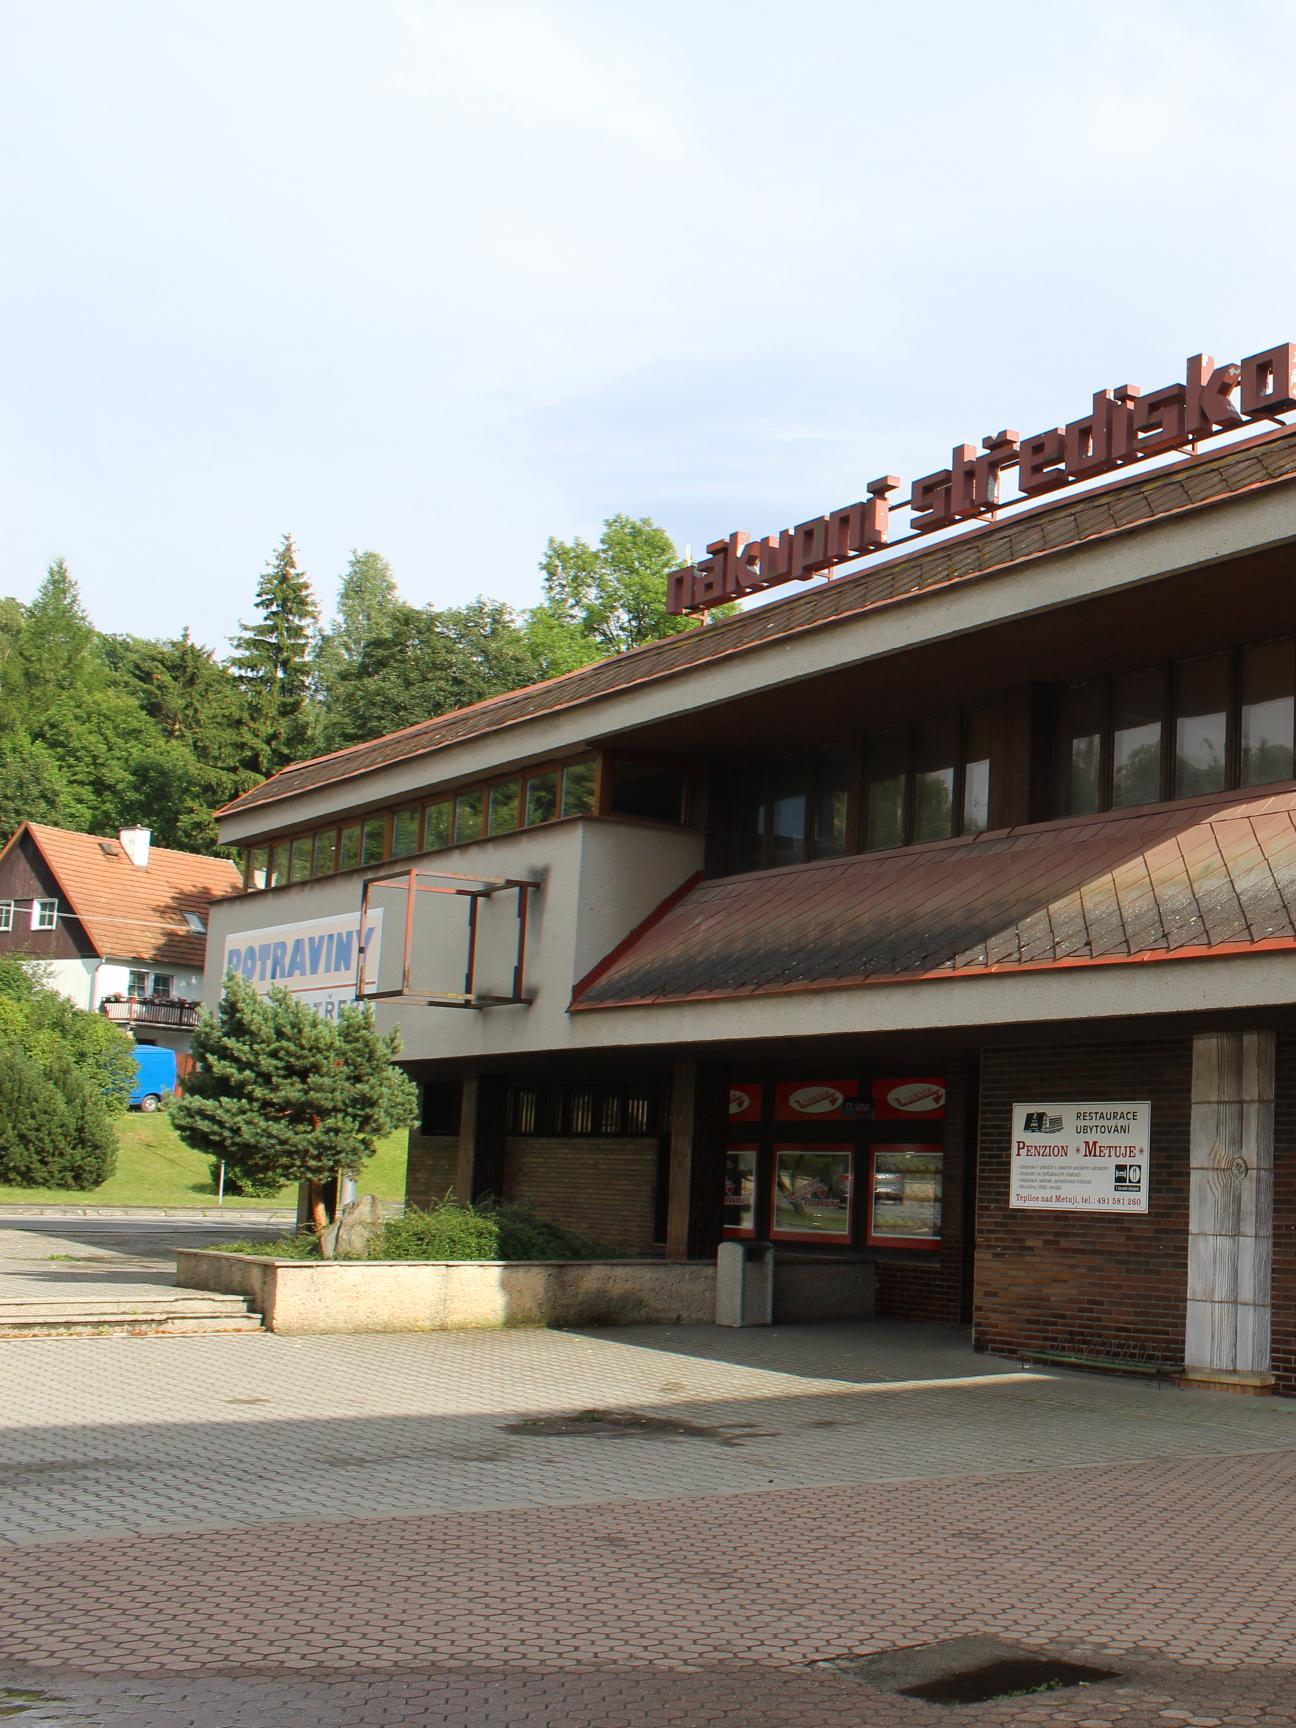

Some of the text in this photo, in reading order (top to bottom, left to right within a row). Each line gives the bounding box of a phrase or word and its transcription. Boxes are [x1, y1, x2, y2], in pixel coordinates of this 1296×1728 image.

[227, 926, 376, 981] POTRAVINY
[1075, 1111, 1138, 1121] RESTAURACE
[1075, 1123, 1130, 1134] UBYTOVÁNÍ
[1016, 1194, 1040, 1203] Teplice
[1041, 1194, 1053, 1203] nad
[1097, 1197, 1110, 1205] 491
[1112, 1197, 1125, 1205] 581
[1127, 1198, 1141, 1206] 260
